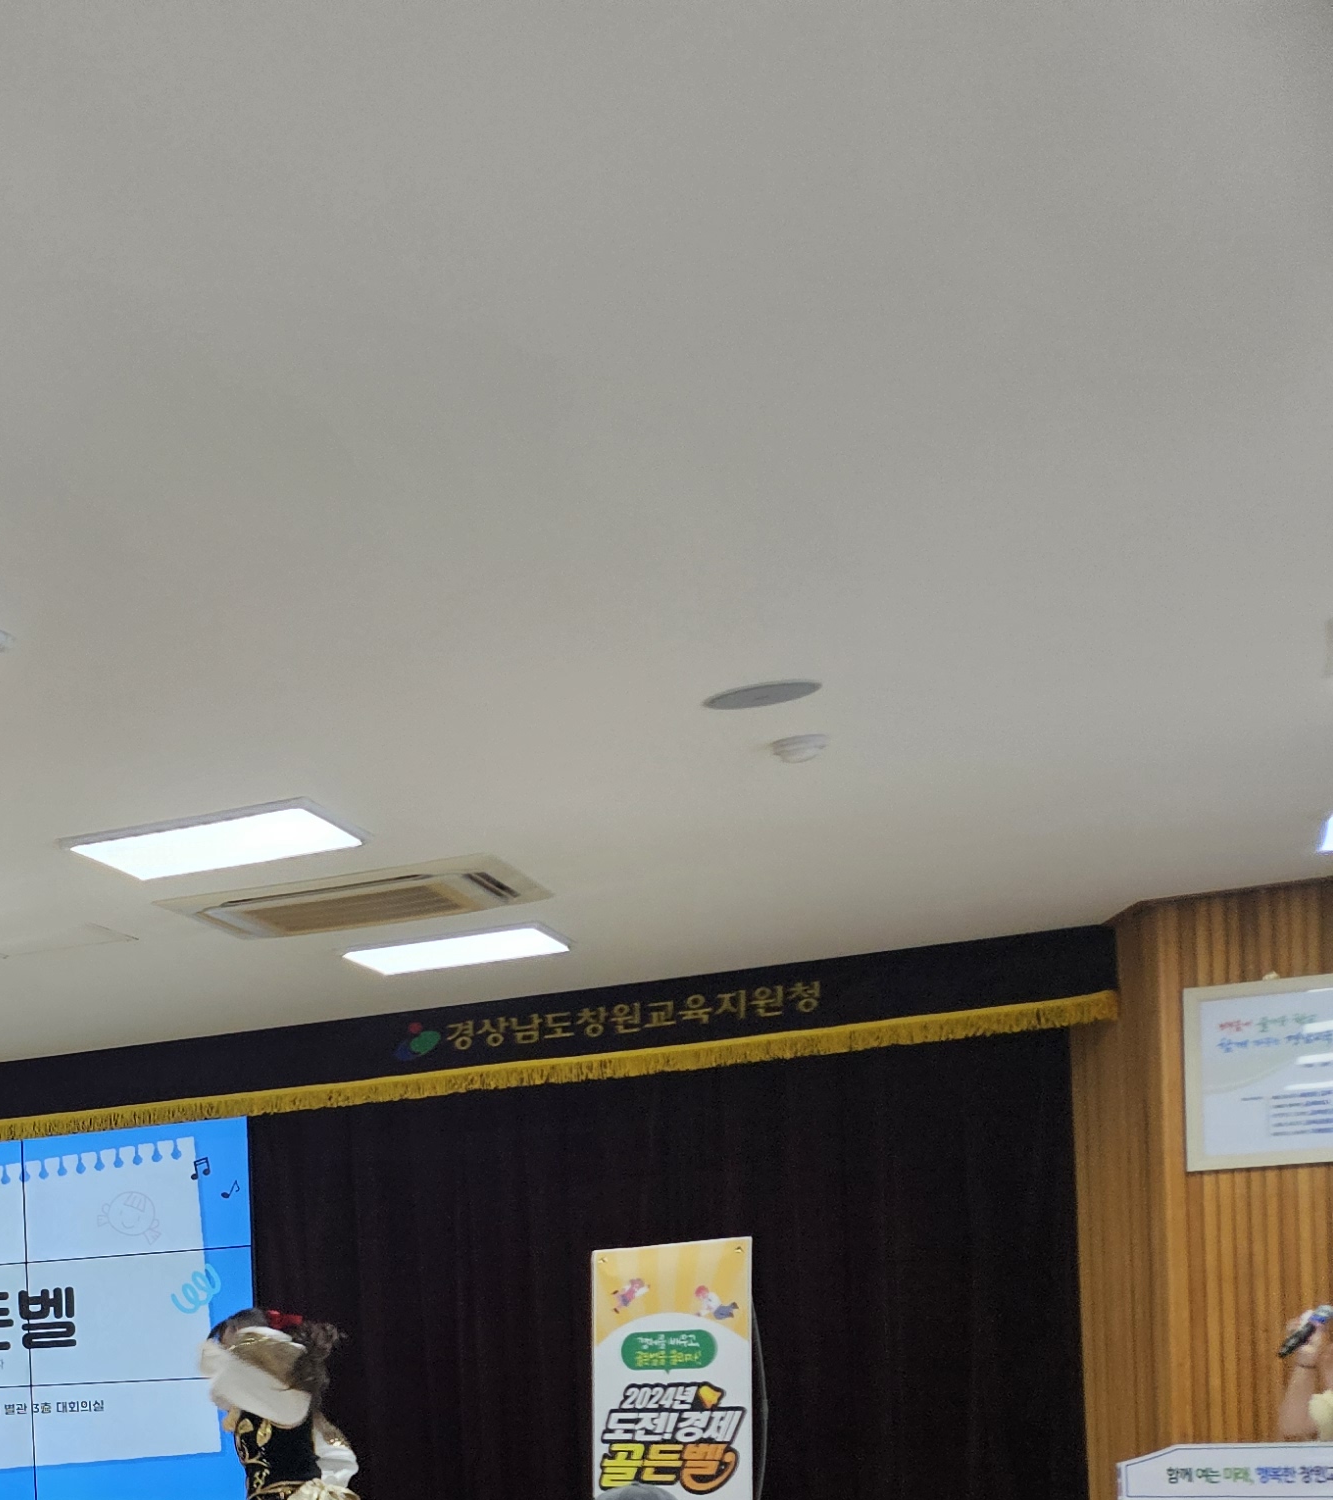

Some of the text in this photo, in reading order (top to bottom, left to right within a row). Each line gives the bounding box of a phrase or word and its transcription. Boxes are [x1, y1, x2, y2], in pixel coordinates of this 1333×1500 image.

[445, 979, 823, 1051] 경상남도창원교육지원청
[4, 1403, 28, 1416] 별관
[56, 1399, 105, 1413] 대회의실
[620, 1385, 698, 1410] 2024년
[601, 1409, 742, 1443] 도전! 경제
[600, 1442, 736, 1491] 골든벨
